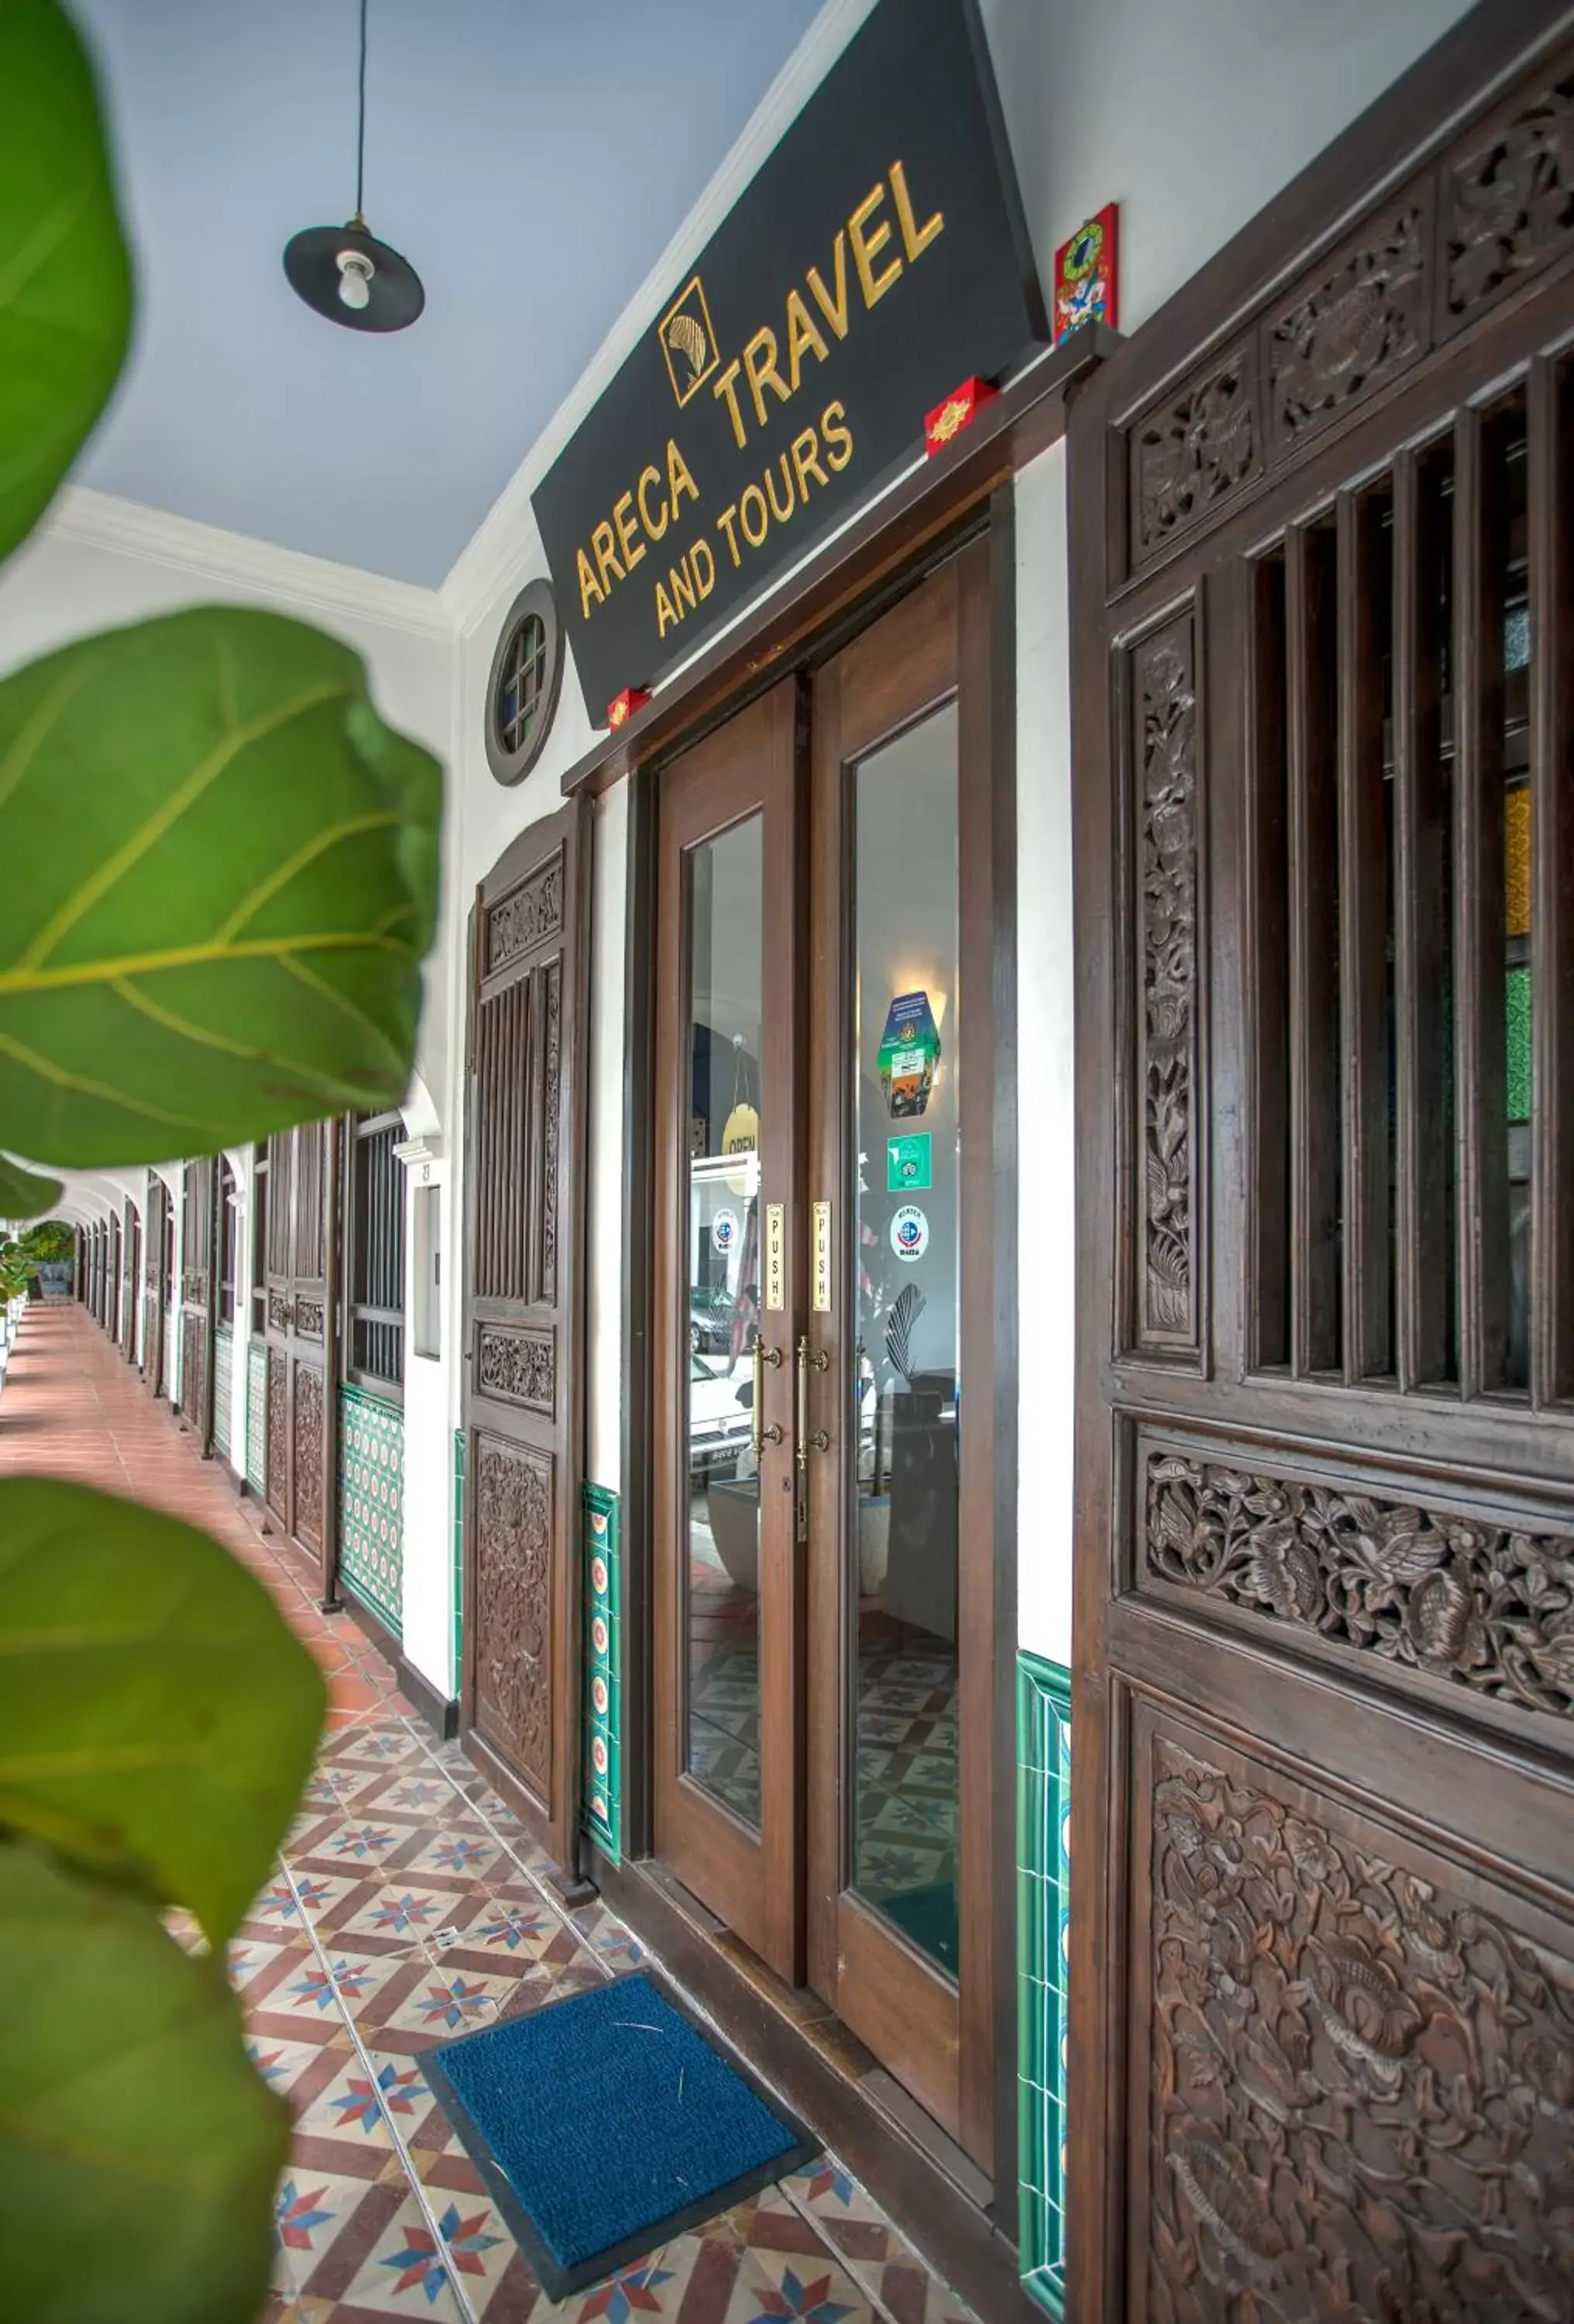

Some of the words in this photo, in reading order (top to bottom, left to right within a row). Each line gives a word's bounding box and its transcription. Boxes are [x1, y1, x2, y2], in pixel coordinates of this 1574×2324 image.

[576, 438, 699, 621] ARECA
[713, 159, 944, 449] TRAVEL
[655, 538, 715, 638] AND
[716, 401, 853, 568] TOURS
[730, 1136, 755, 1154] OPEN
